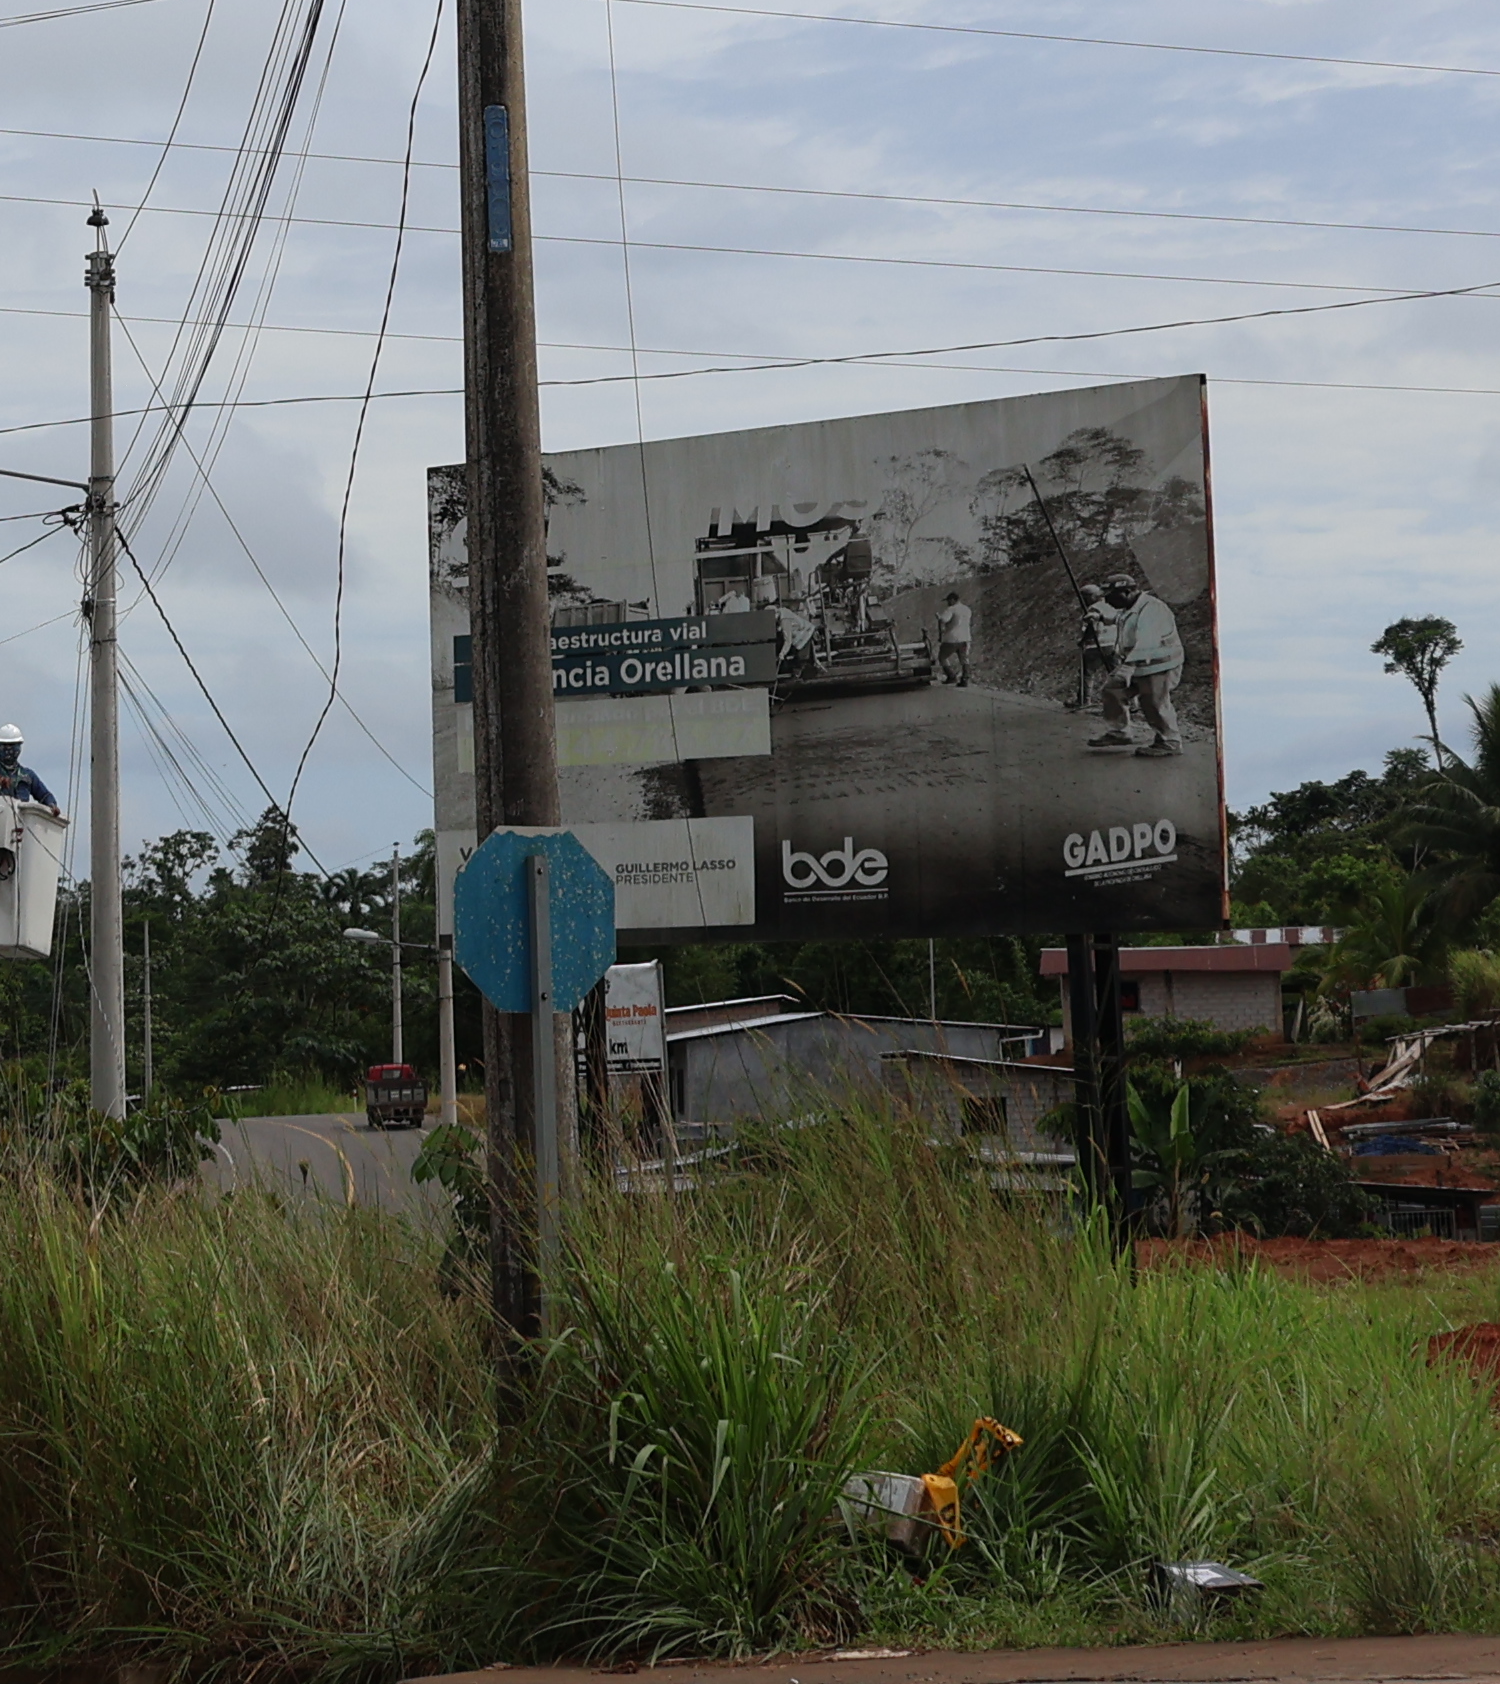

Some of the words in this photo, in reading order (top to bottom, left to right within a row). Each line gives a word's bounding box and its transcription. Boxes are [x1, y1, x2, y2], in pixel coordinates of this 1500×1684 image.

[550, 628, 662, 650] aestructura
[669, 621, 707, 641] vial
[551, 660, 610, 689] ncia
[620, 653, 746, 684] Orellana
[1063, 818, 1177, 868] GADPO
[615, 860, 689, 874] GUILLERMO
[692, 859, 736, 872] LASSO
[782, 836, 889, 889] bde
[615, 871, 694, 885] PRESIDENTE
[609, 1038, 628, 1055] km
